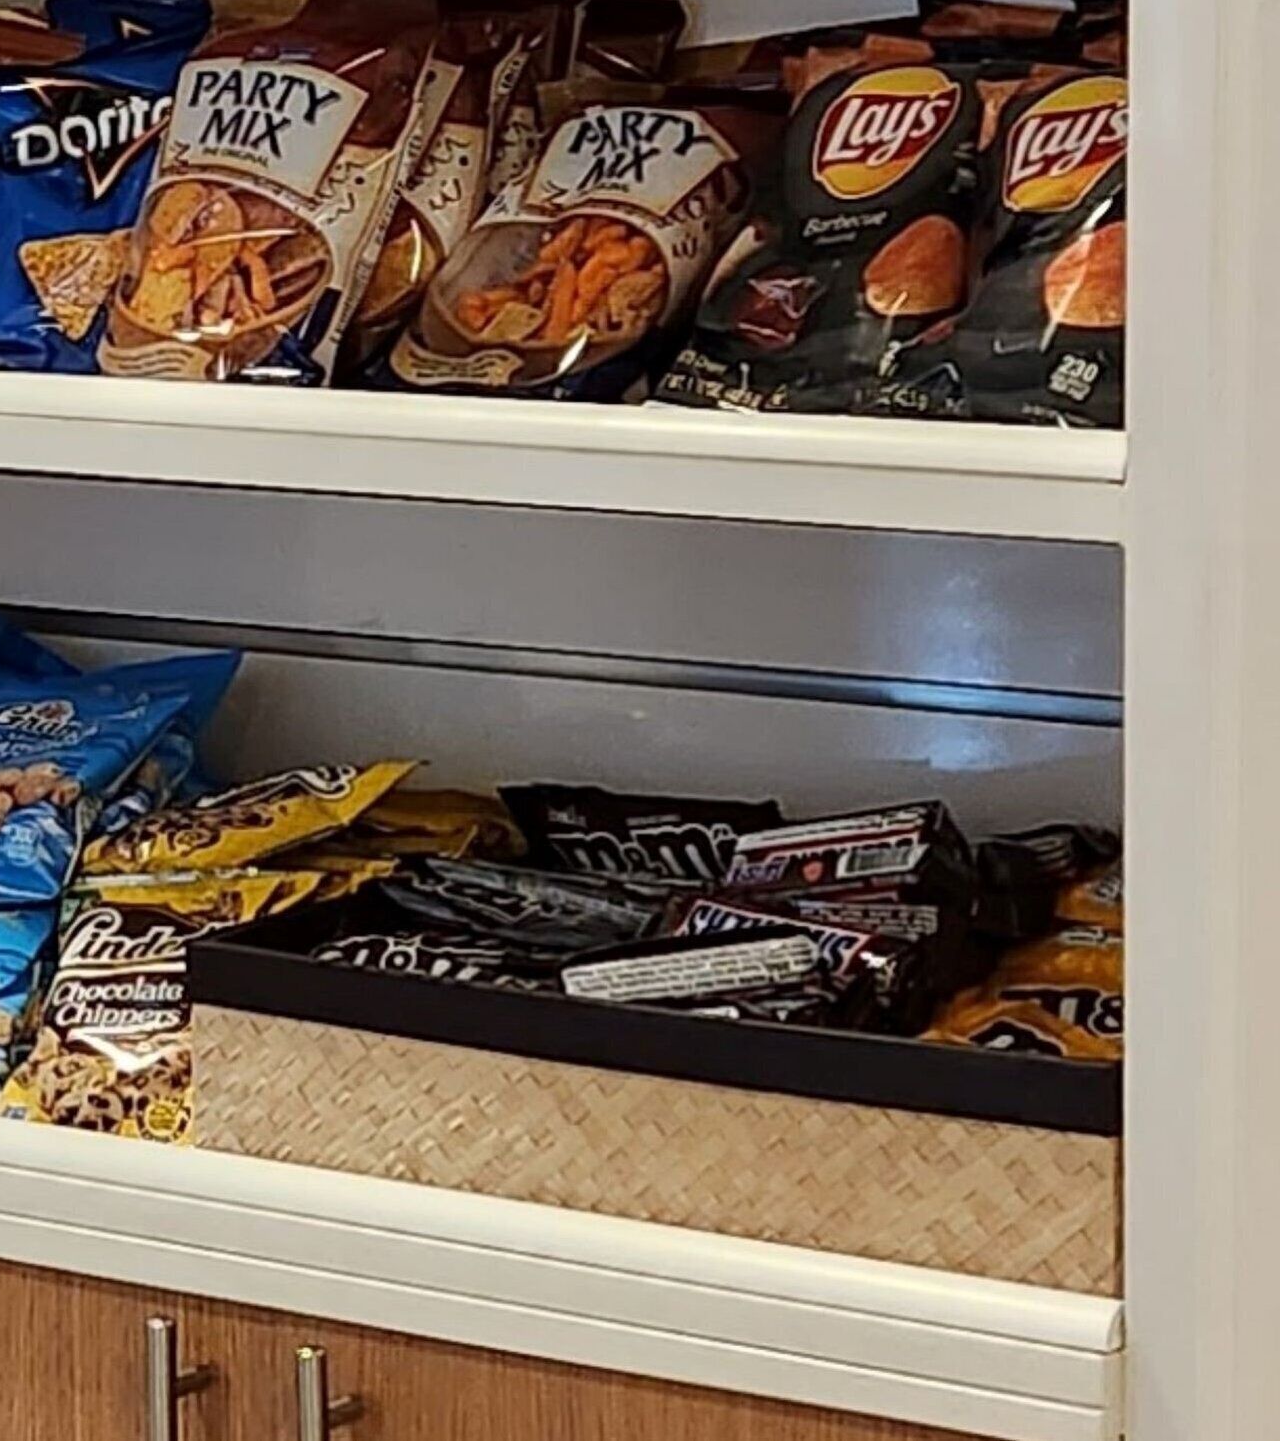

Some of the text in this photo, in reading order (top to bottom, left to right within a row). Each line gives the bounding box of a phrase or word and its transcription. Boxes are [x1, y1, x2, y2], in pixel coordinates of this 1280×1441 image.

[188, 69, 341, 125] PARTY
[199, 108, 293, 158] MIX
[567, 111, 714, 156] PARTY
[576, 143, 661, 192] MIX
[1055, 355, 1099, 383] 230
[52, 975, 185, 1006] Chocolate
[54, 1004, 183, 1027] Chippers
